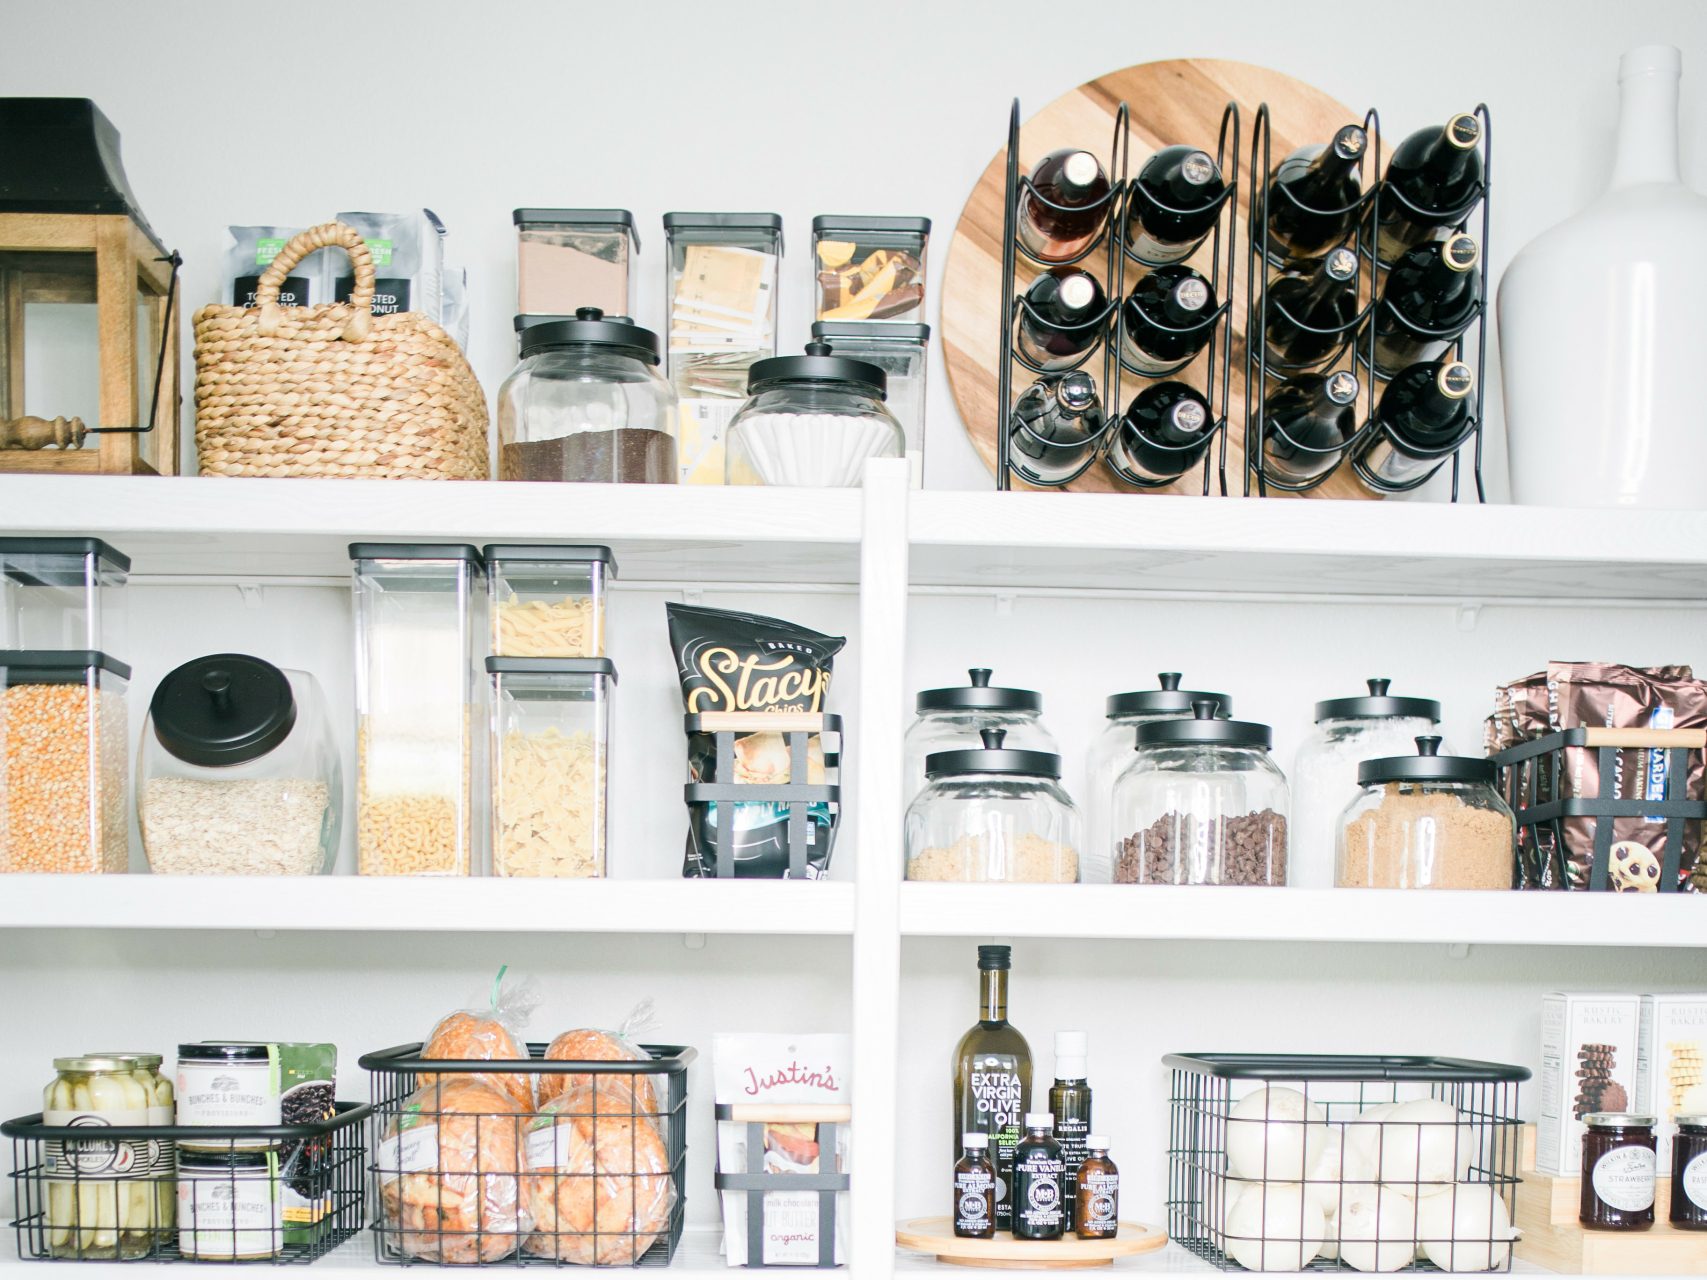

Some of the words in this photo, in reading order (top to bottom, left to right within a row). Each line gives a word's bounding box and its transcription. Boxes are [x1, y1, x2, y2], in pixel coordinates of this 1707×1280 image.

[767, 642, 812, 654] BAKED
[744, 1061, 839, 1096] Justin's
[971, 1073, 1021, 1086] EXTRA
[971, 1086, 1021, 1099] VIRGIN
[976, 1099, 1021, 1112] OLIVE
[994, 1112, 1020, 1125] OIL
[1017, 1164, 1038, 1172] PURE
[770, 1232, 815, 1246] organic
